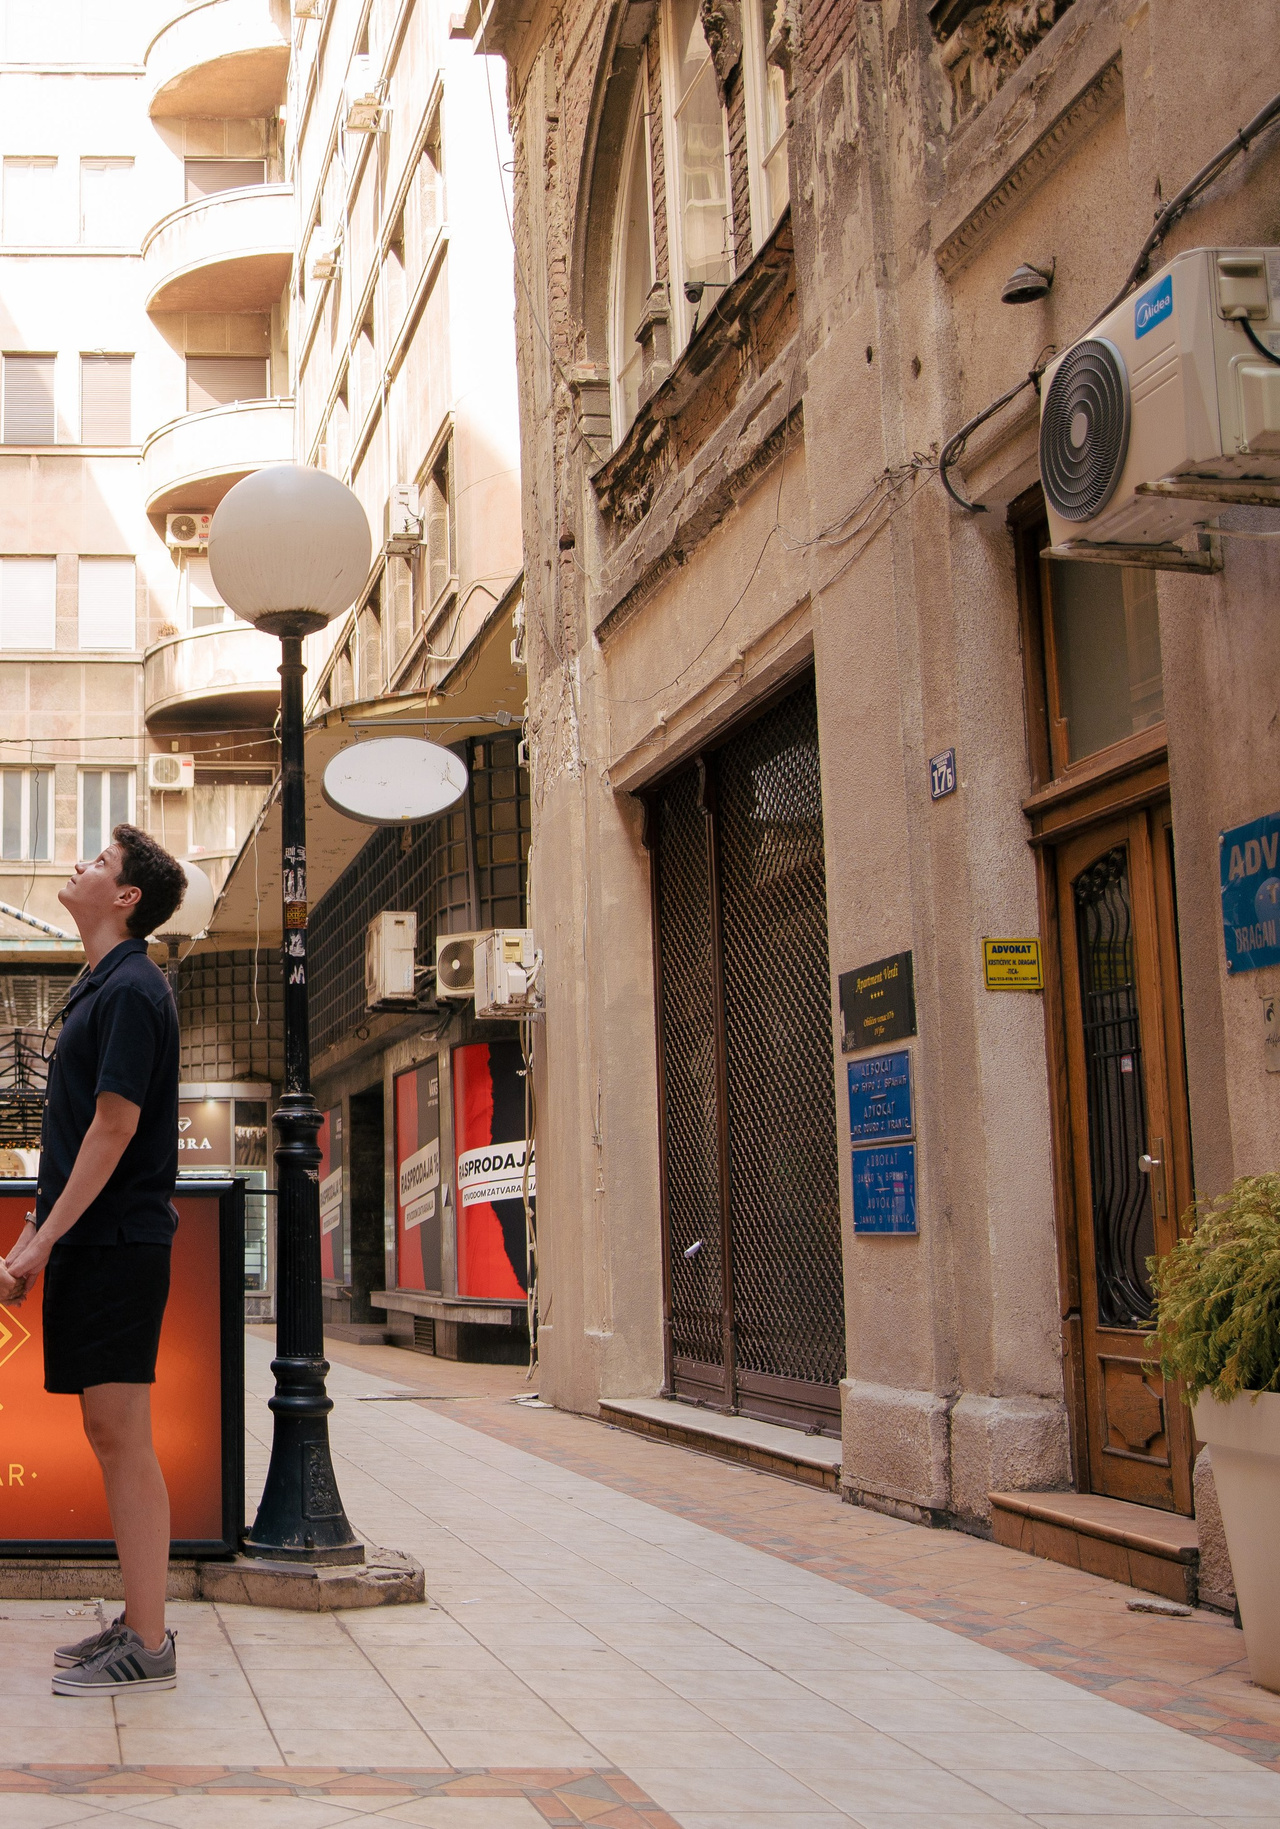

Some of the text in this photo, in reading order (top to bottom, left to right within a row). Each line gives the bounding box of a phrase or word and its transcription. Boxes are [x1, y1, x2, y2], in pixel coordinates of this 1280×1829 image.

[1137, 294, 1171, 328] Midea
[1228, 832, 1279, 882] ADV
[991, 945, 1032, 954] ADVOKAT
[1235, 919, 1277, 954] DRAGAN
[855, 972, 883, 994] Apartment
[401, 1155, 433, 1194] RASPRODAJA
[486, 1183, 536, 1197] ZATVARAJ
